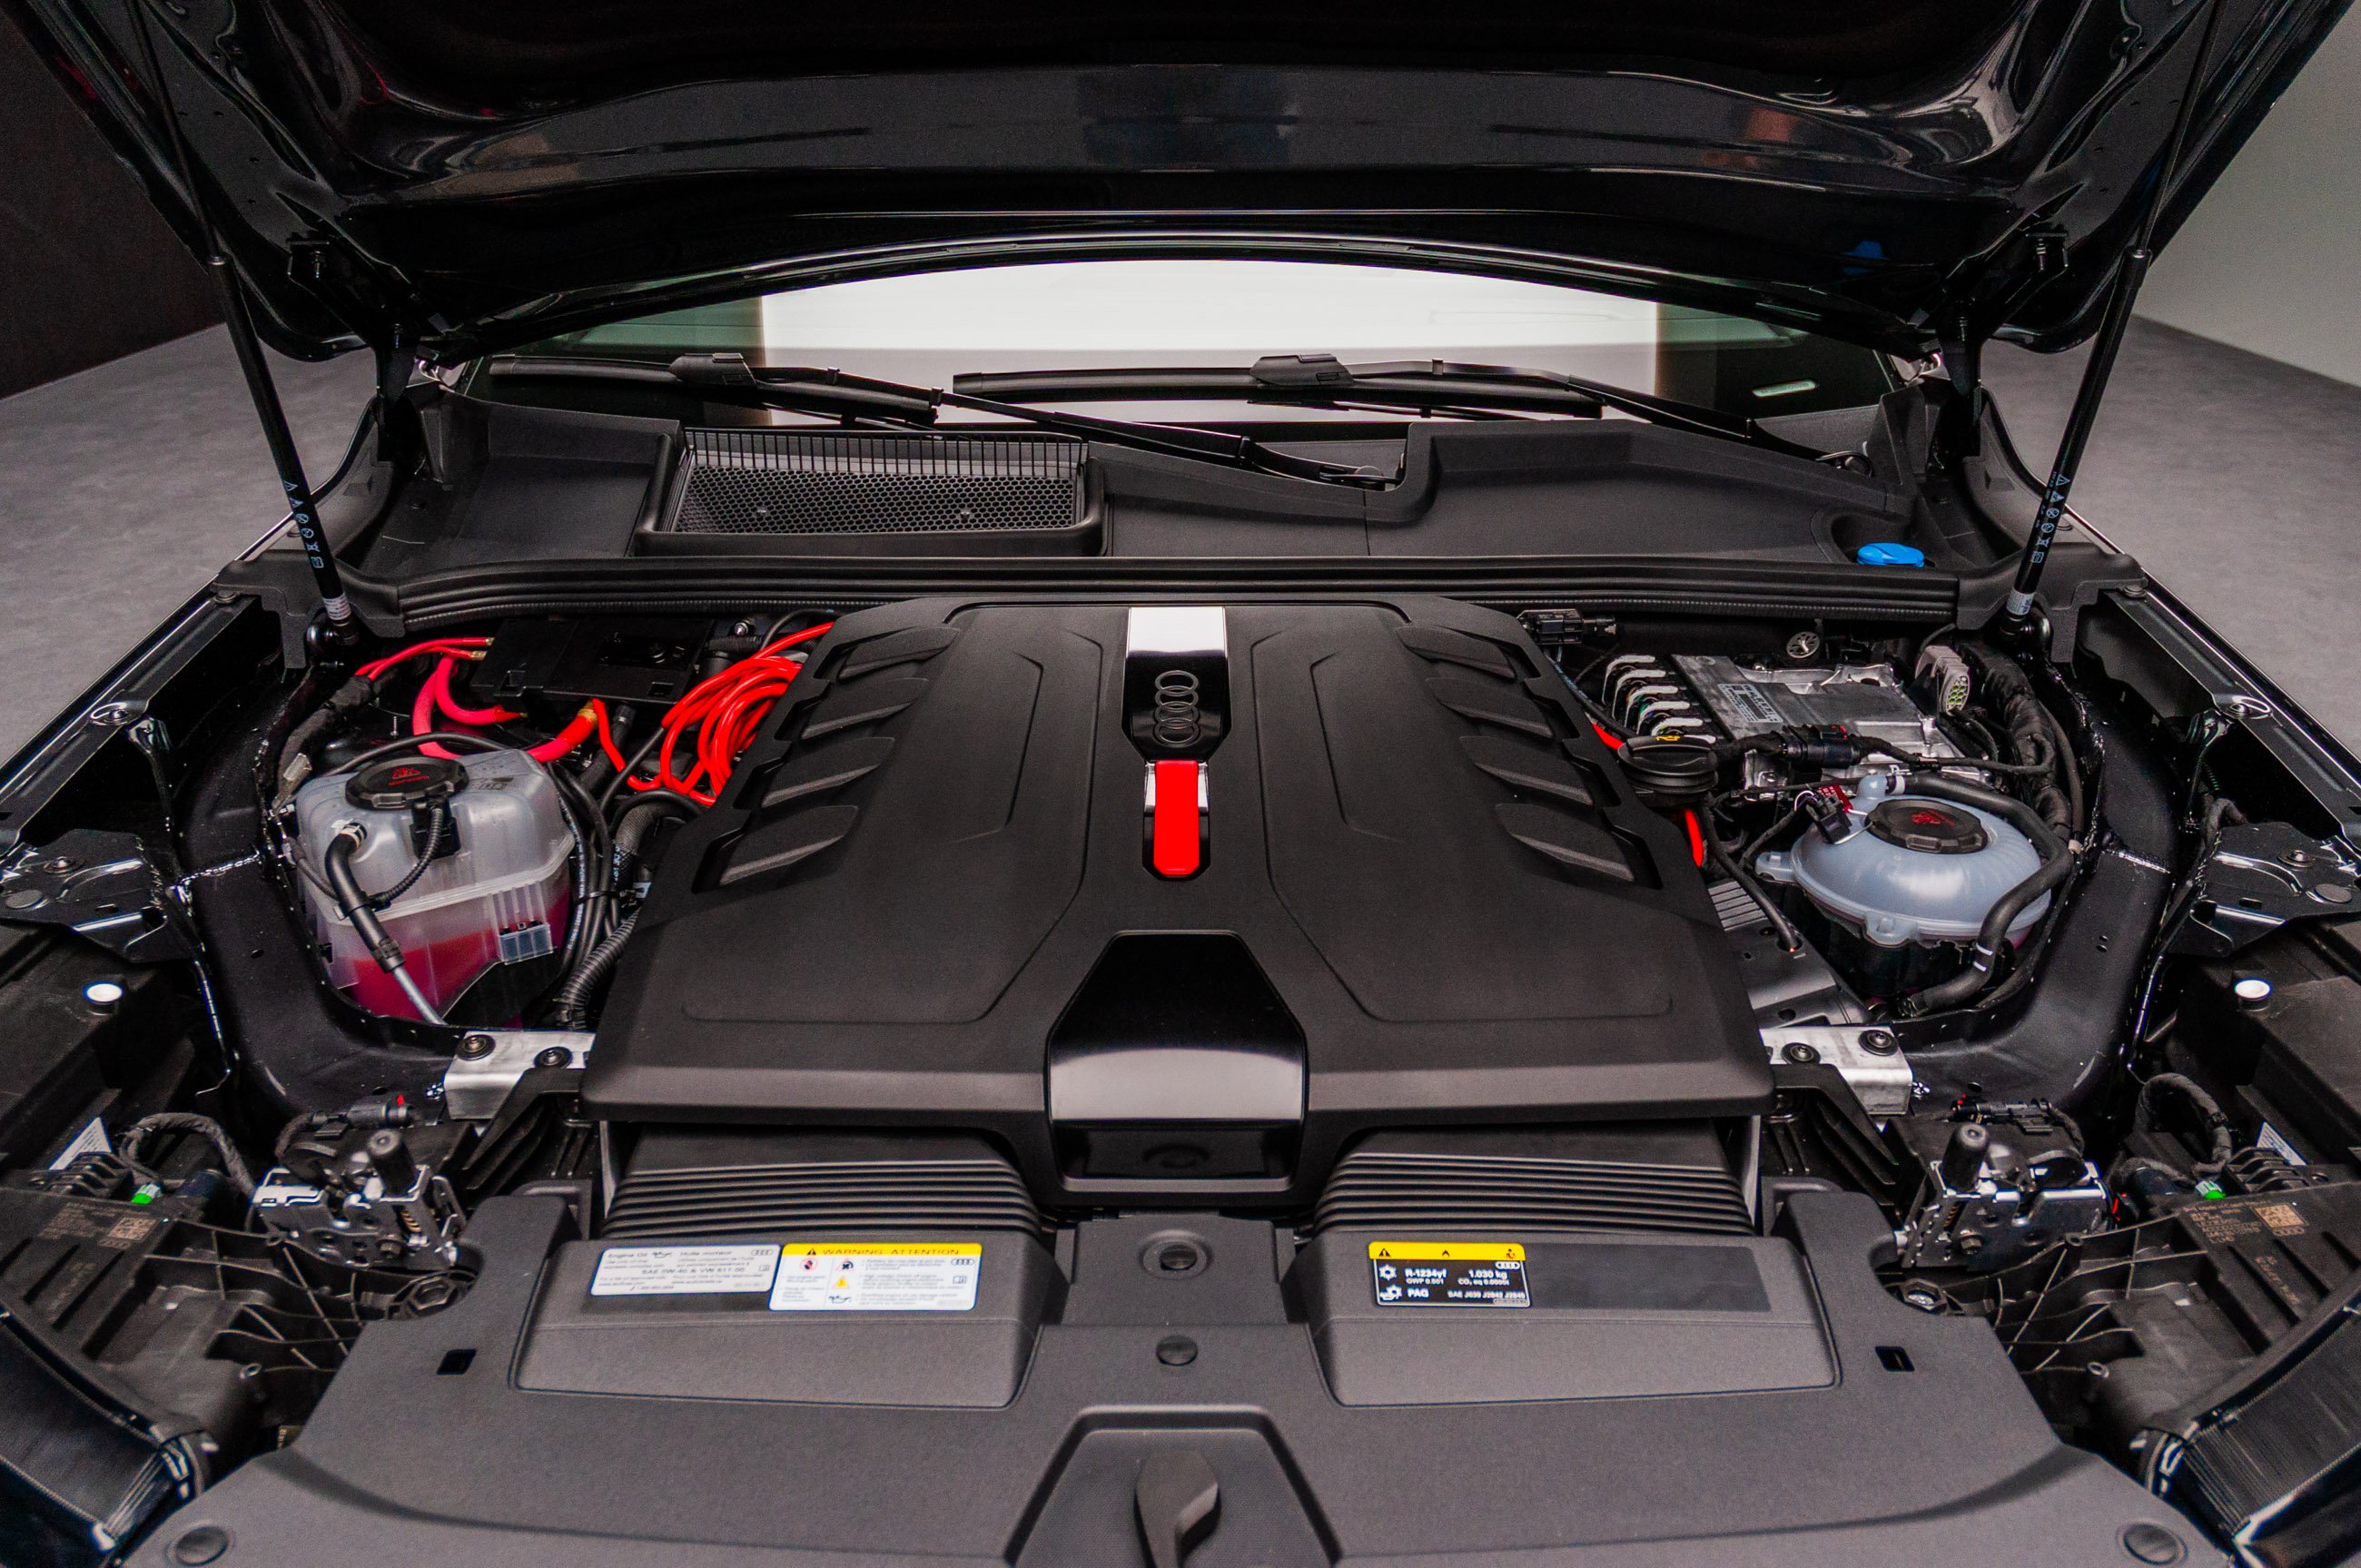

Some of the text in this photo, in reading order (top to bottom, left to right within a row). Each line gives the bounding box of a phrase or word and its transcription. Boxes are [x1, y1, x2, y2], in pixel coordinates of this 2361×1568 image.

[1404, 1268, 1447, 1278] R-1234yf
[1467, 1269, 1507, 1280] 1.030 kg
[1407, 1288, 1429, 1298] PAG
[1447, 1290, 1463, 1298] SAE
